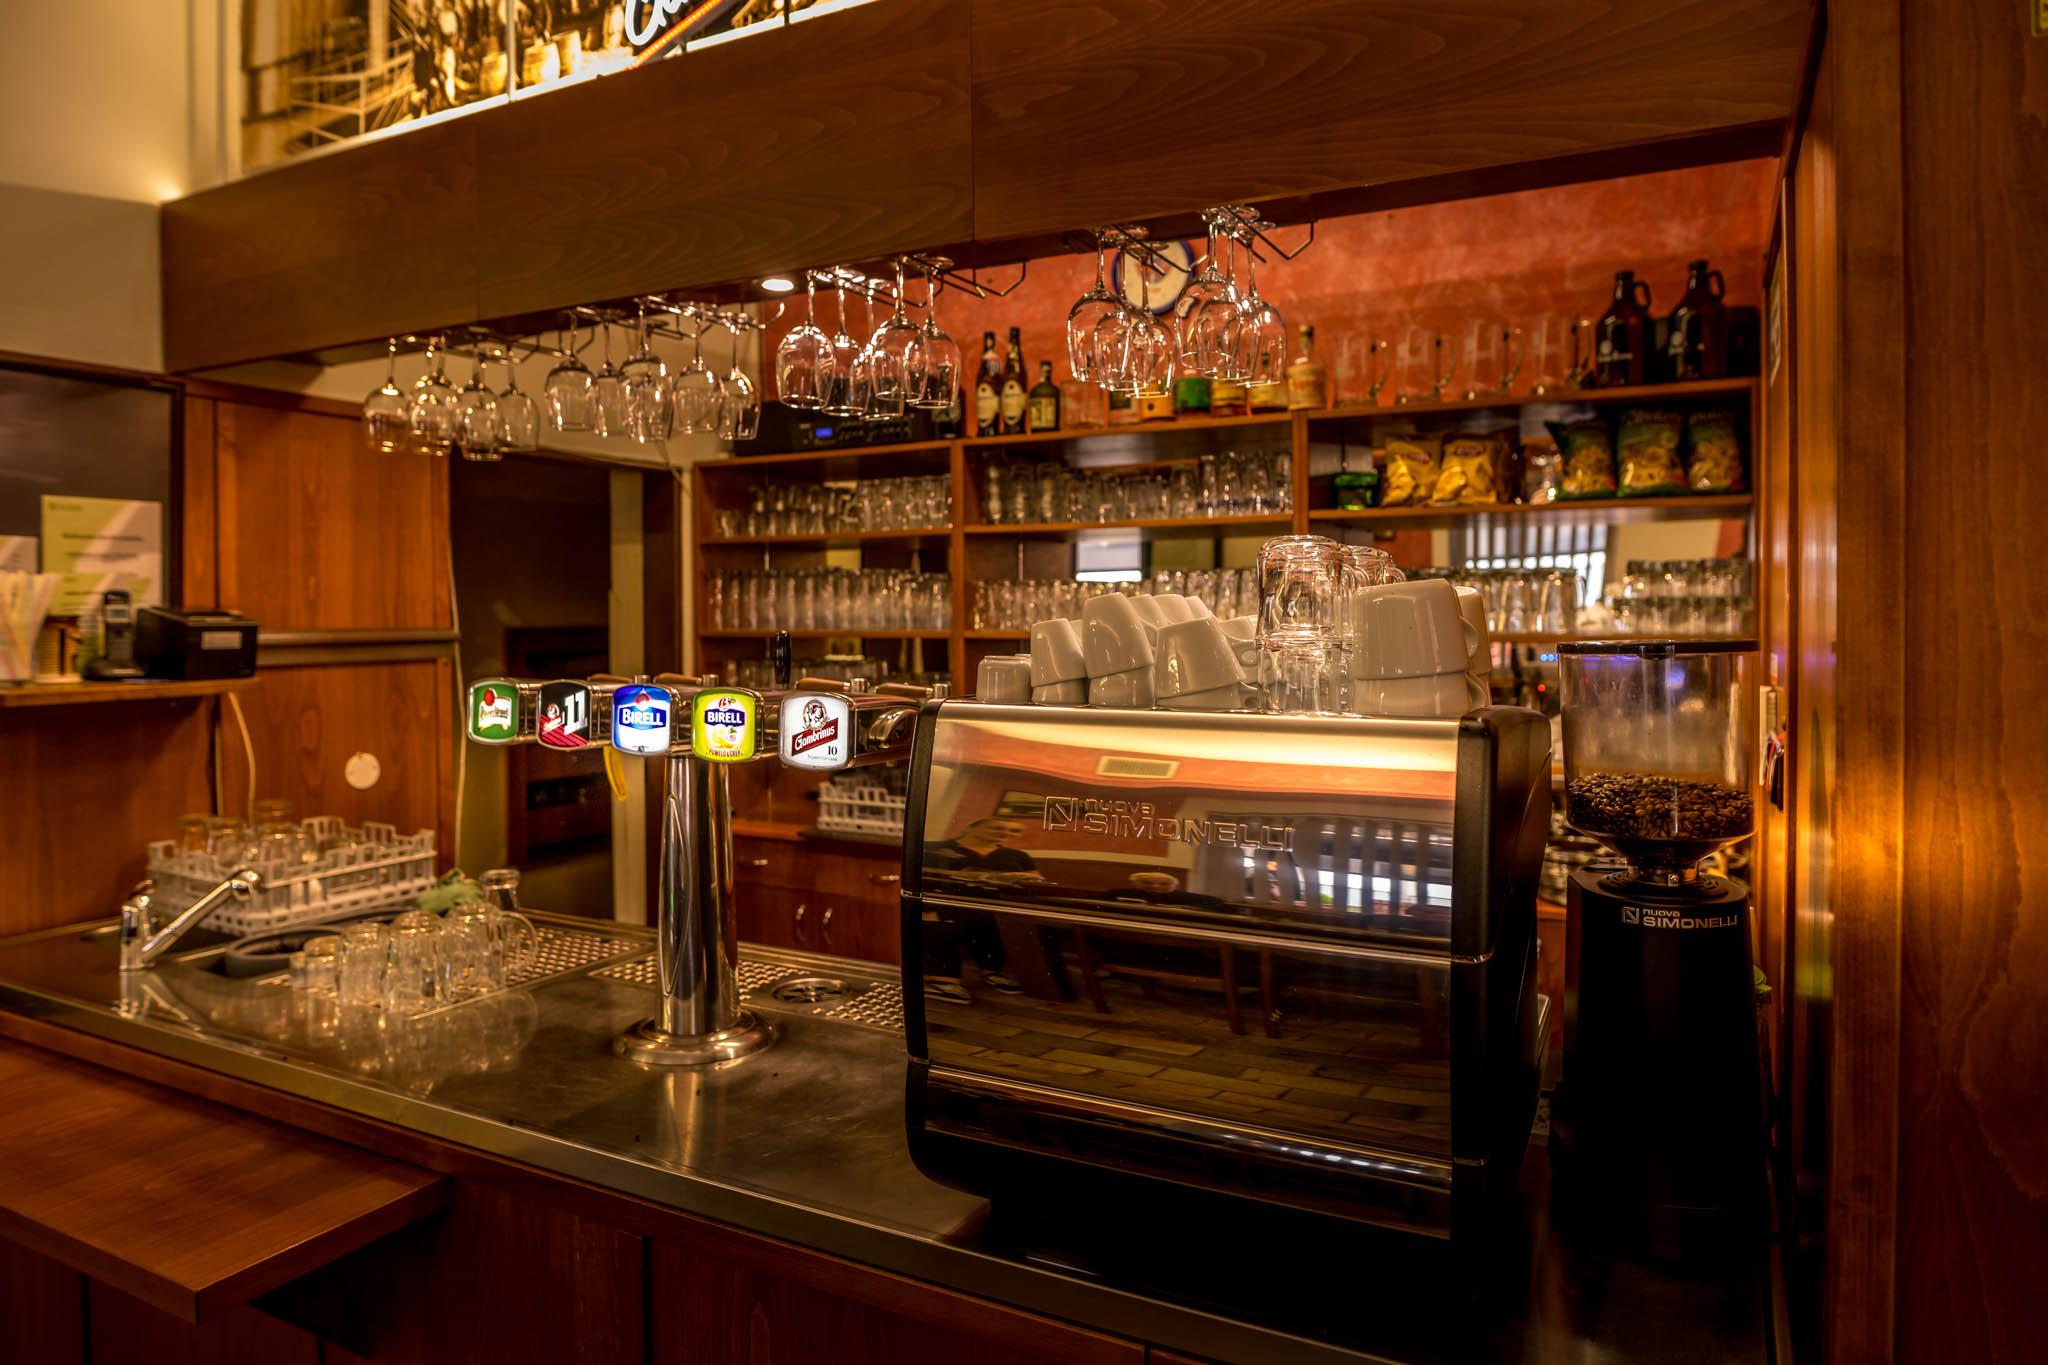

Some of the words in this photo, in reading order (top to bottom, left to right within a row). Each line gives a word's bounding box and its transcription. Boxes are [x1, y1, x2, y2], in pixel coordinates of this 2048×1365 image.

[564, 690, 588, 735] 11
[622, 708, 663, 726] BIRELL
[707, 711, 742, 724] BIRELL
[827, 745, 838, 756] 10
[1084, 798, 1155, 816] nuova
[1083, 812, 1296, 852] SIMONELLI
[1642, 908, 1680, 917] nuova
[1643, 914, 1738, 929] SIMONELLI
